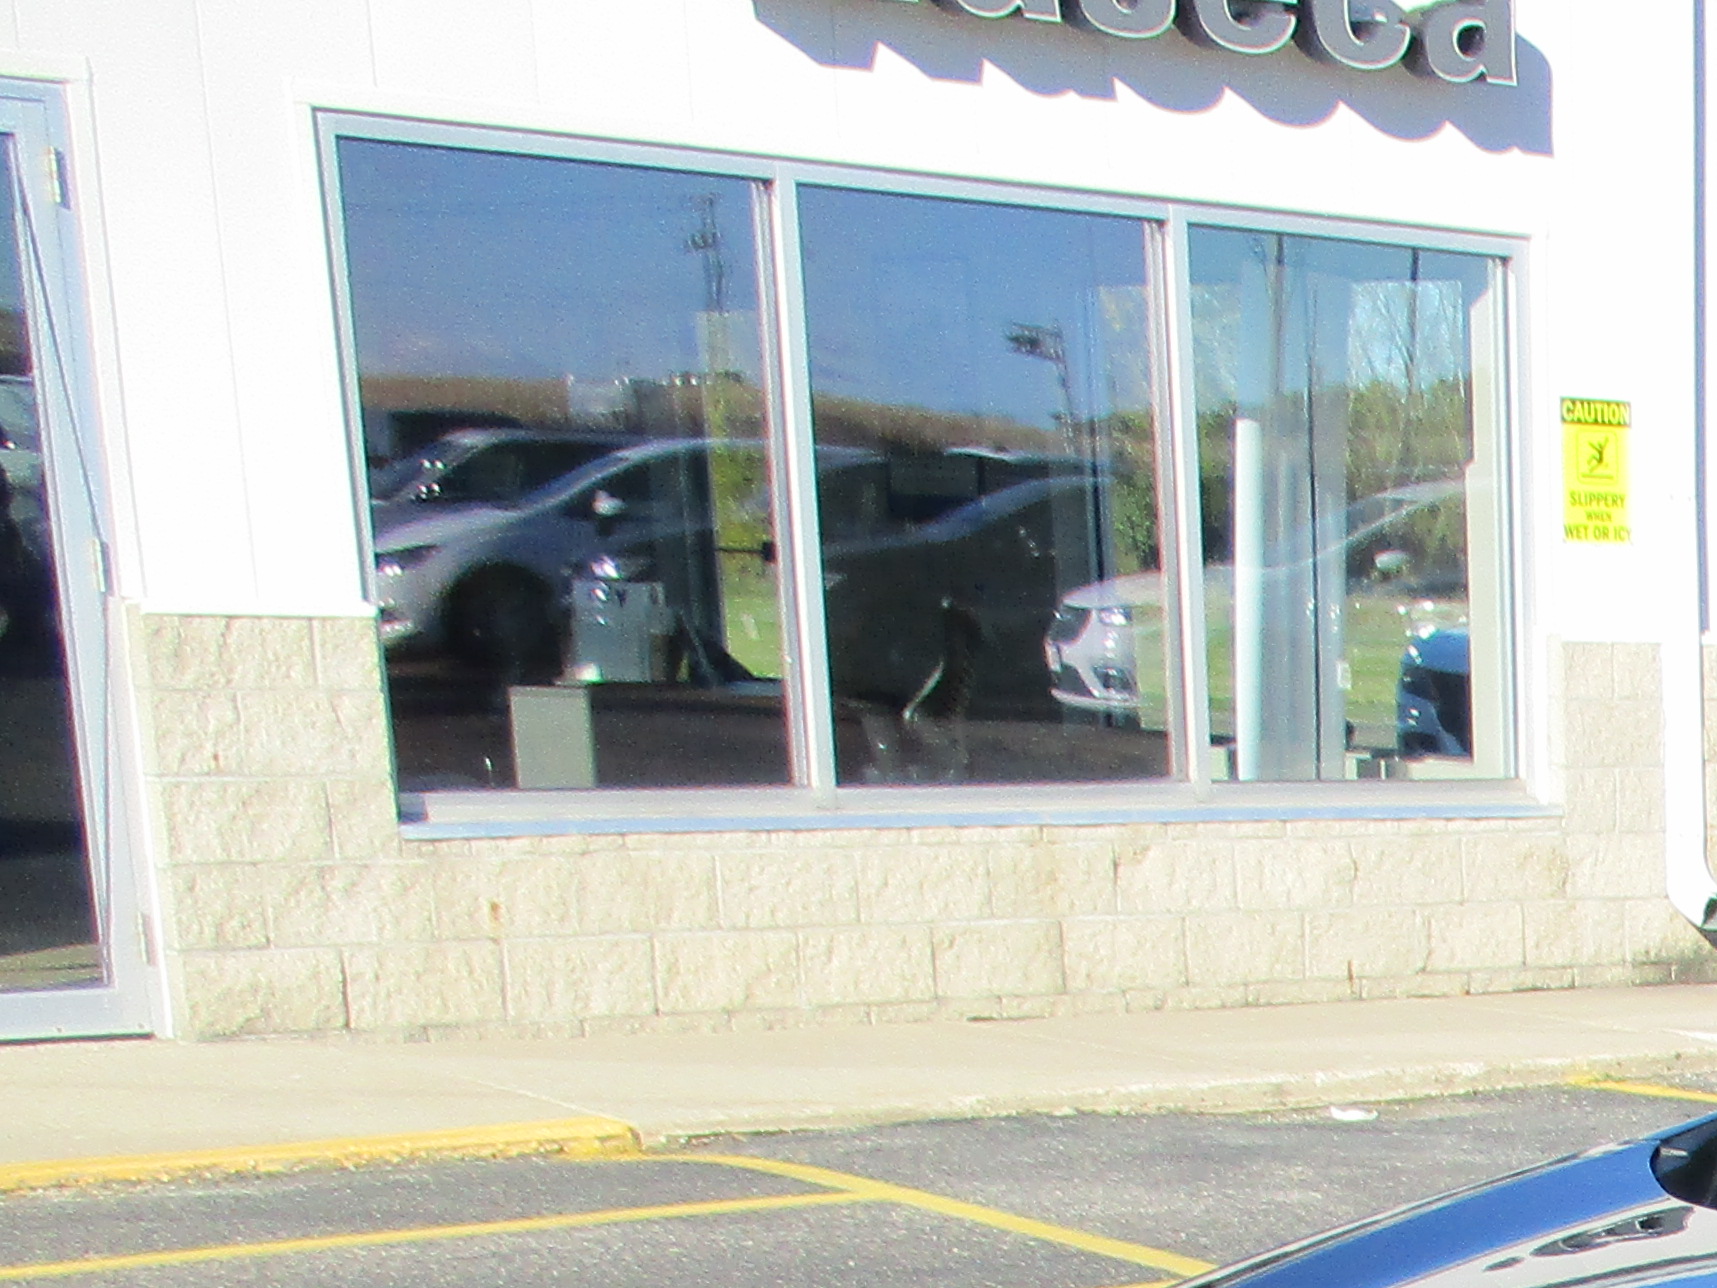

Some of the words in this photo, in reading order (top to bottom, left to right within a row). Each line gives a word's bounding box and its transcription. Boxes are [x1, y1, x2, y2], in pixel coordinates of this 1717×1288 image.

[1562, 398, 1631, 426] CAUTION
[1569, 490, 1626, 509] SLIPPERY
[1585, 510, 1612, 522] WHEN
[1564, 524, 1589, 541] WET
[1593, 525, 1610, 541] OR
[1613, 526, 1632, 543] ICY
